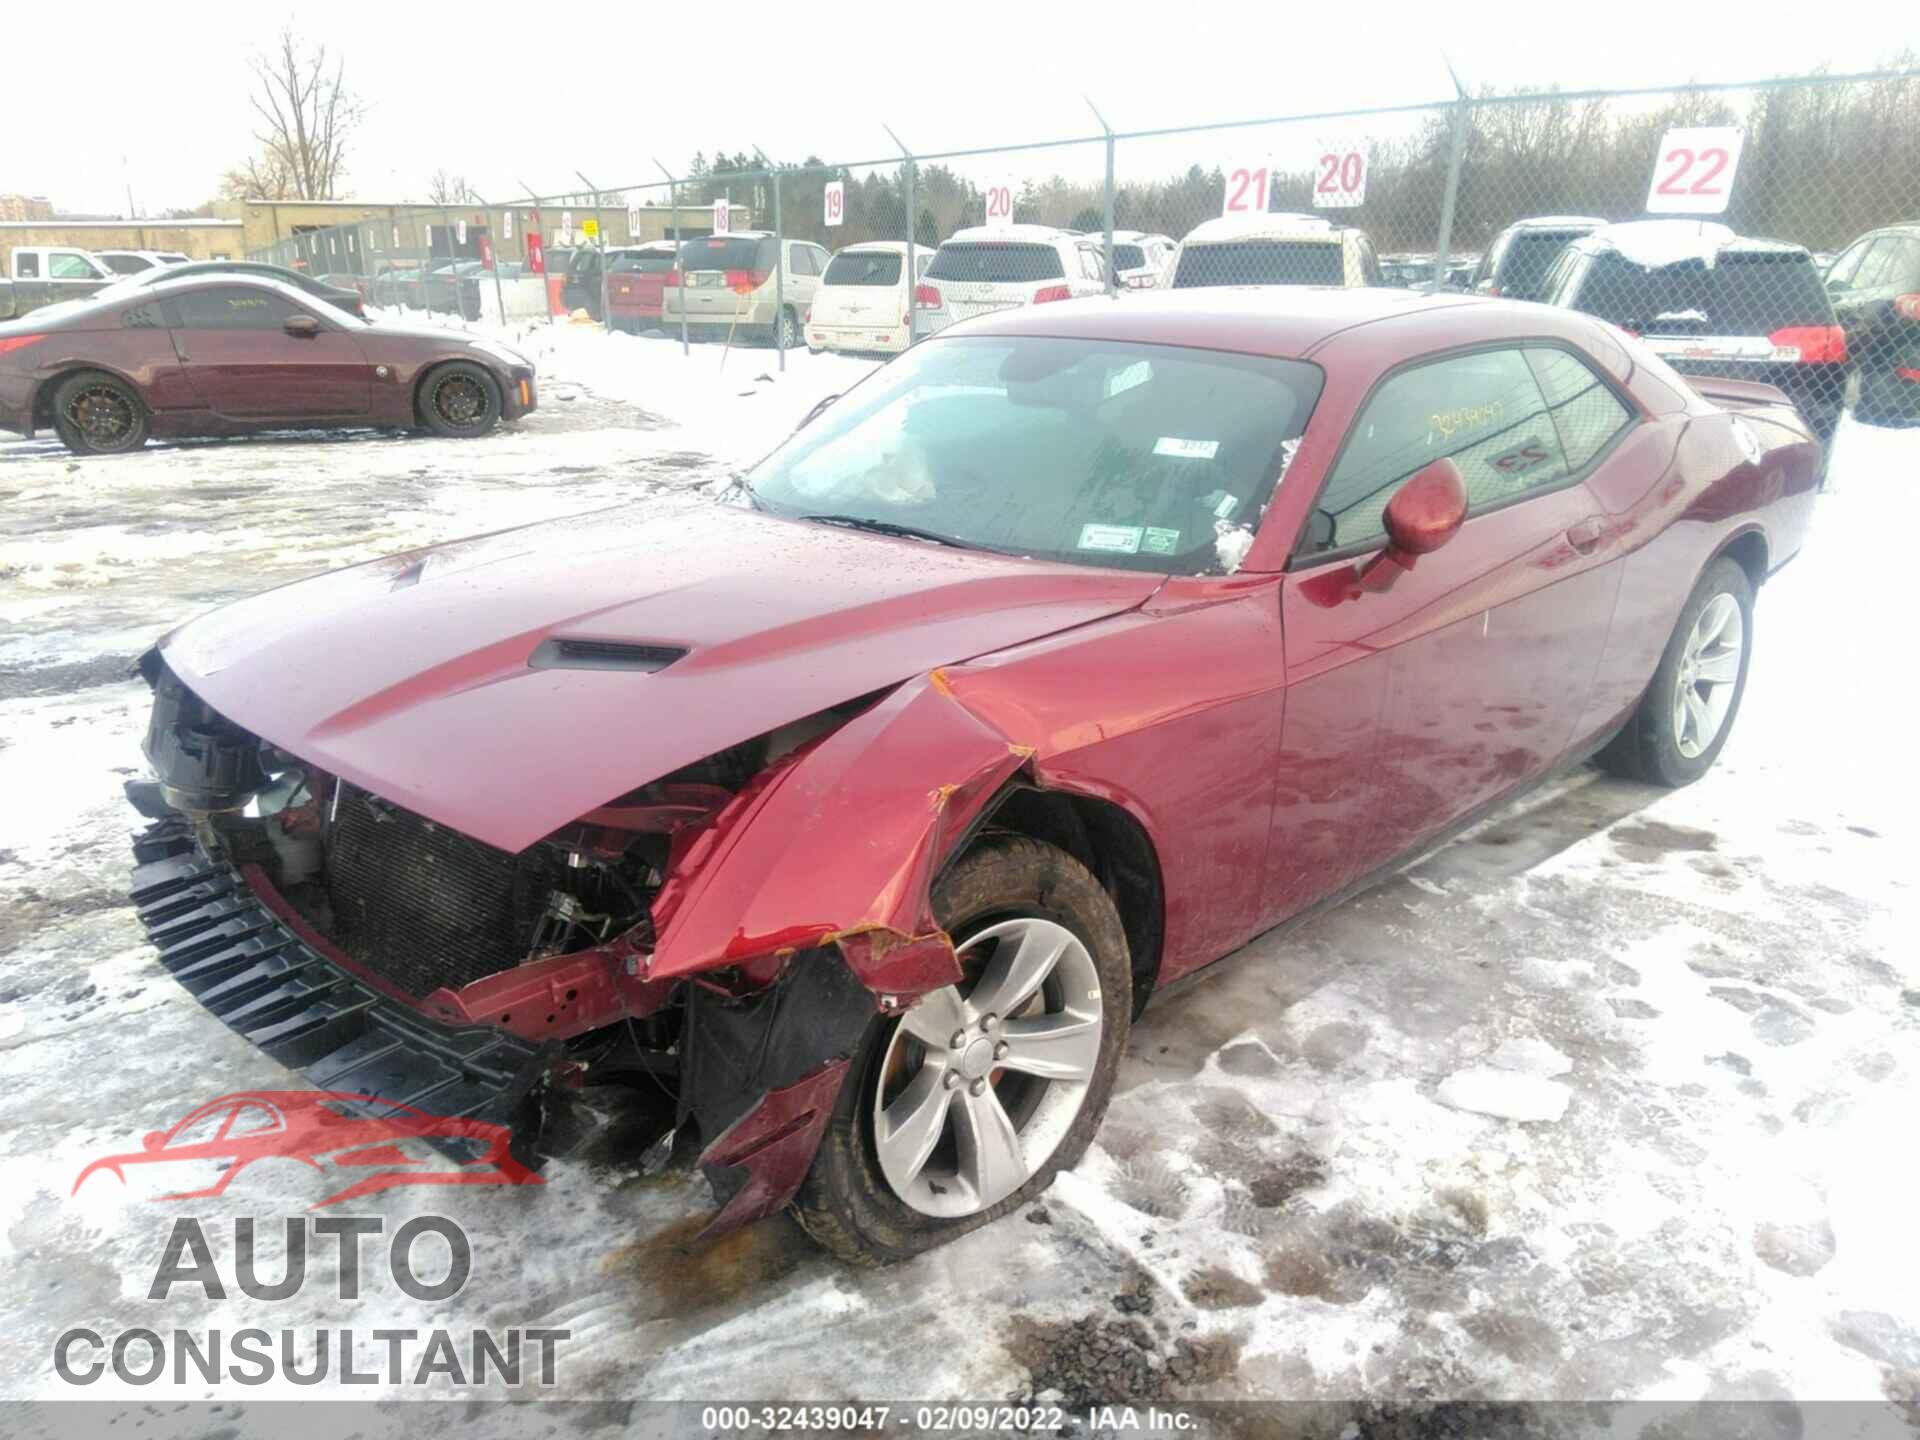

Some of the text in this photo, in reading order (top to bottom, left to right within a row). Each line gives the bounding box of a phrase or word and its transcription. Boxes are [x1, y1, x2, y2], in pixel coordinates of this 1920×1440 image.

[1226, 167, 1268, 212] 21
[1317, 151, 1363, 194] 20
[1656, 147, 1729, 195] 22
[715, 205, 728, 230] 18
[826, 189, 842, 219] 19
[987, 186, 1010, 217] 20
